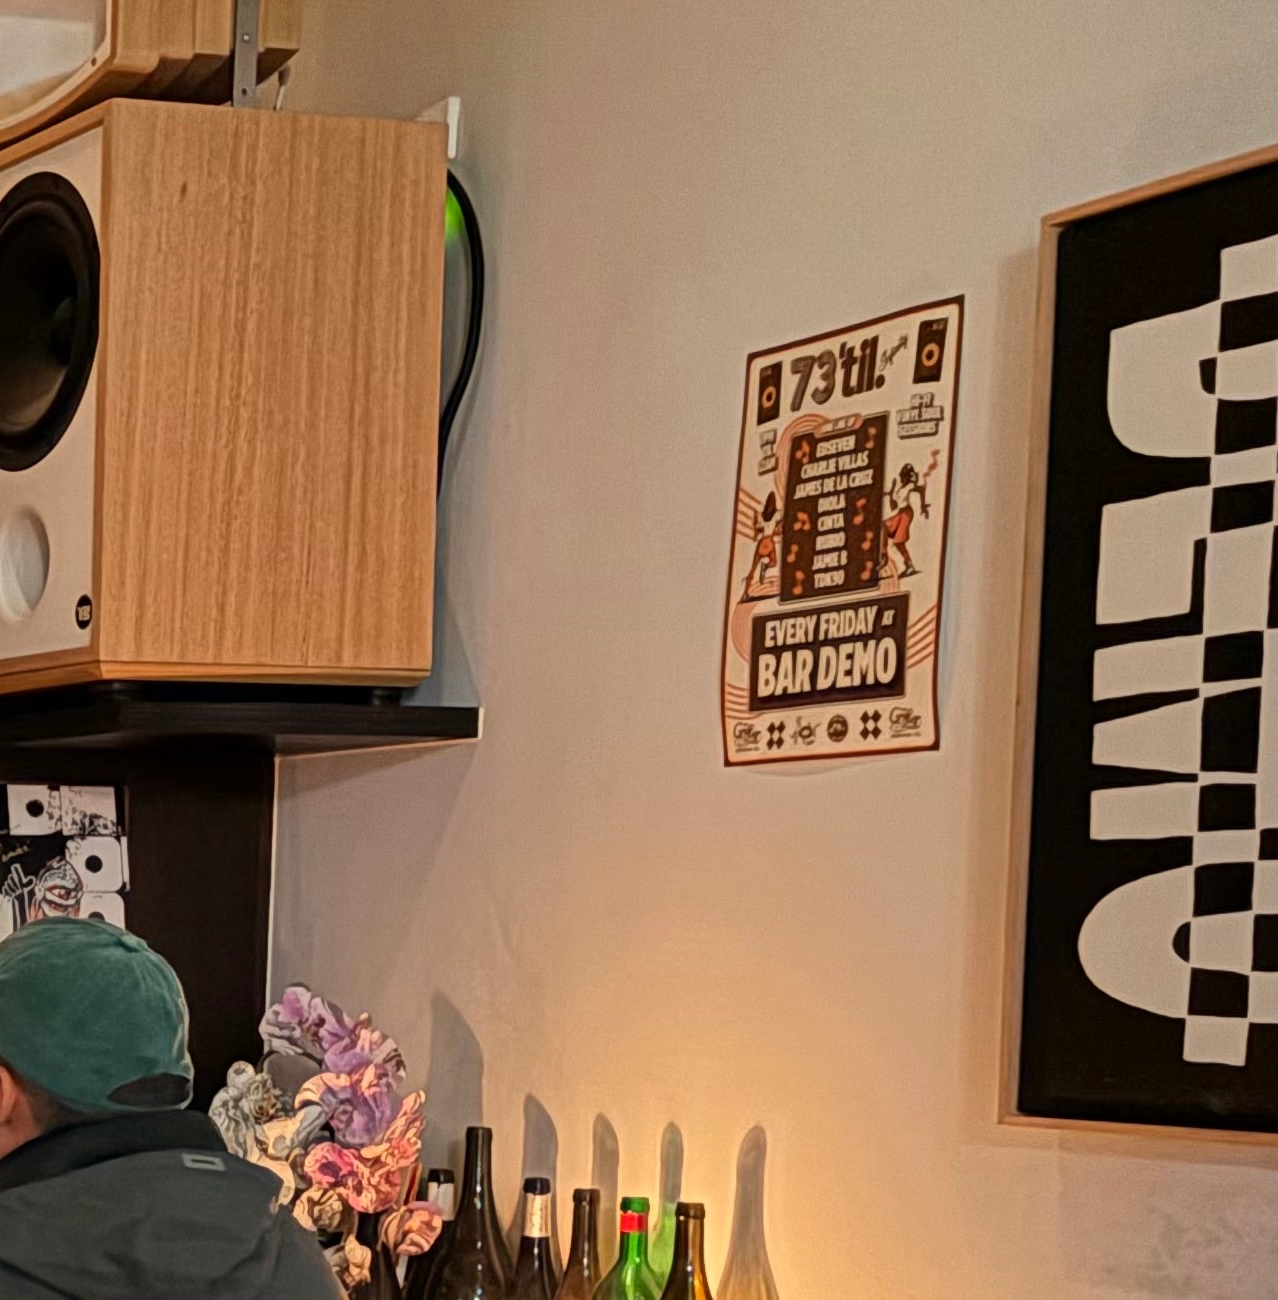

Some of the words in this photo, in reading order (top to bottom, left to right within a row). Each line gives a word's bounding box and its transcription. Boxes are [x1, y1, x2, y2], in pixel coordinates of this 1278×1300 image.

[836, 474, 847, 490] LA
[765, 614, 817, 648] EVERY
[819, 605, 878, 641] FRIDAY
[757, 649, 814, 698] BAR
[816, 637, 897, 691] DEMO
